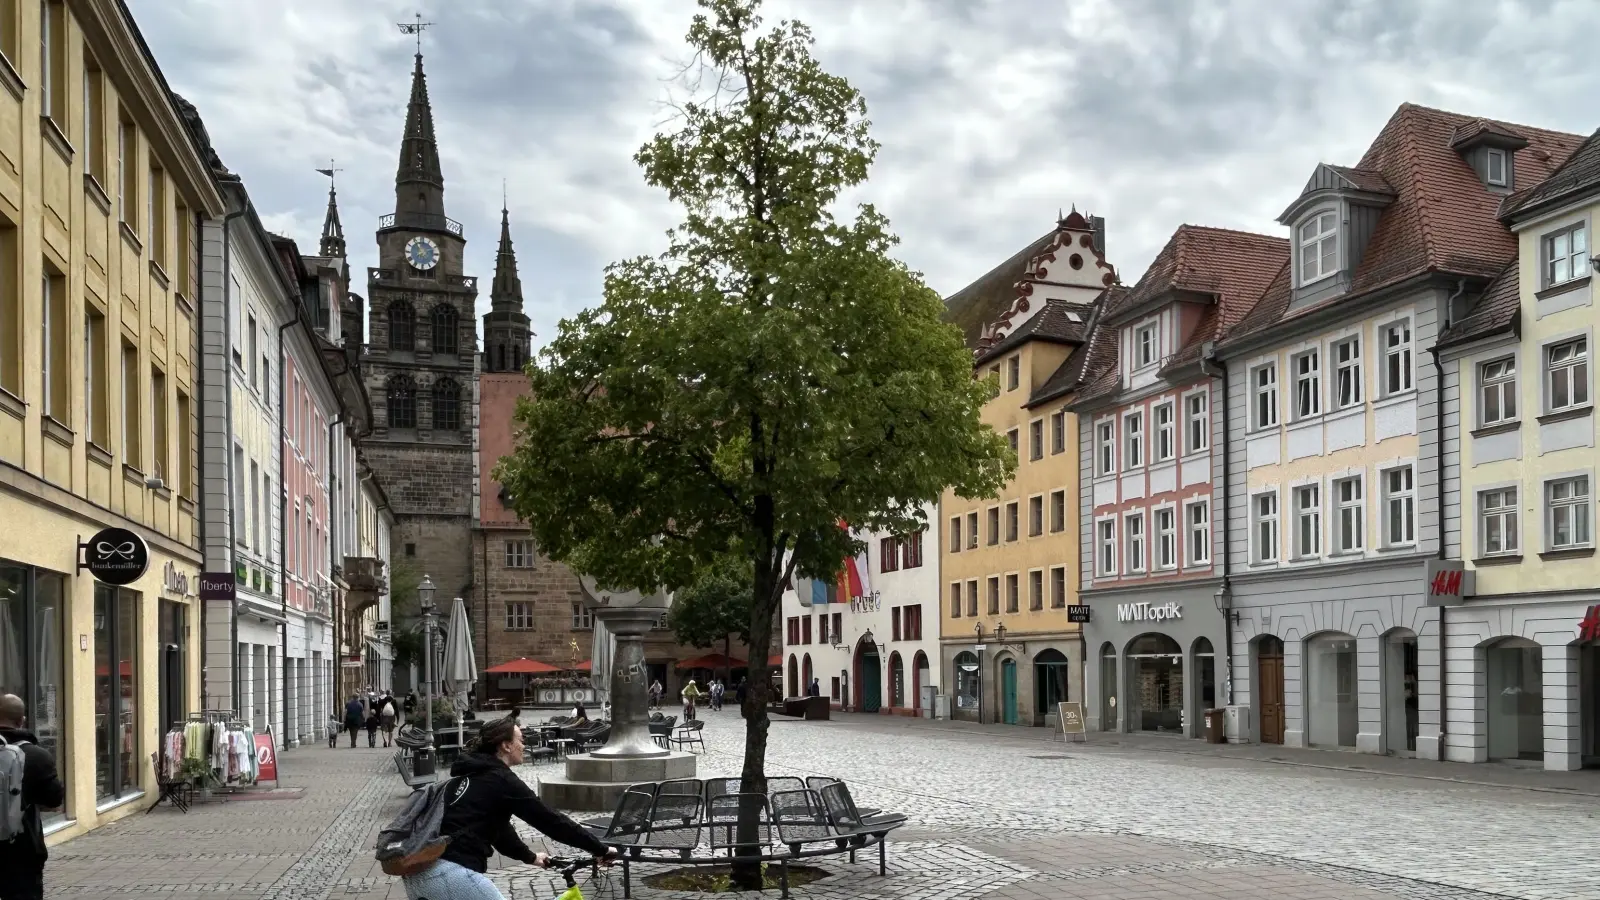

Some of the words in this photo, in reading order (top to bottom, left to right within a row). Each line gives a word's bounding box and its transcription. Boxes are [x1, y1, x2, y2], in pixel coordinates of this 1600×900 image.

[200, 580, 233, 592] liberty
[1431, 570, 1463, 596] H&M
[1070, 606, 1088, 615] MATT
